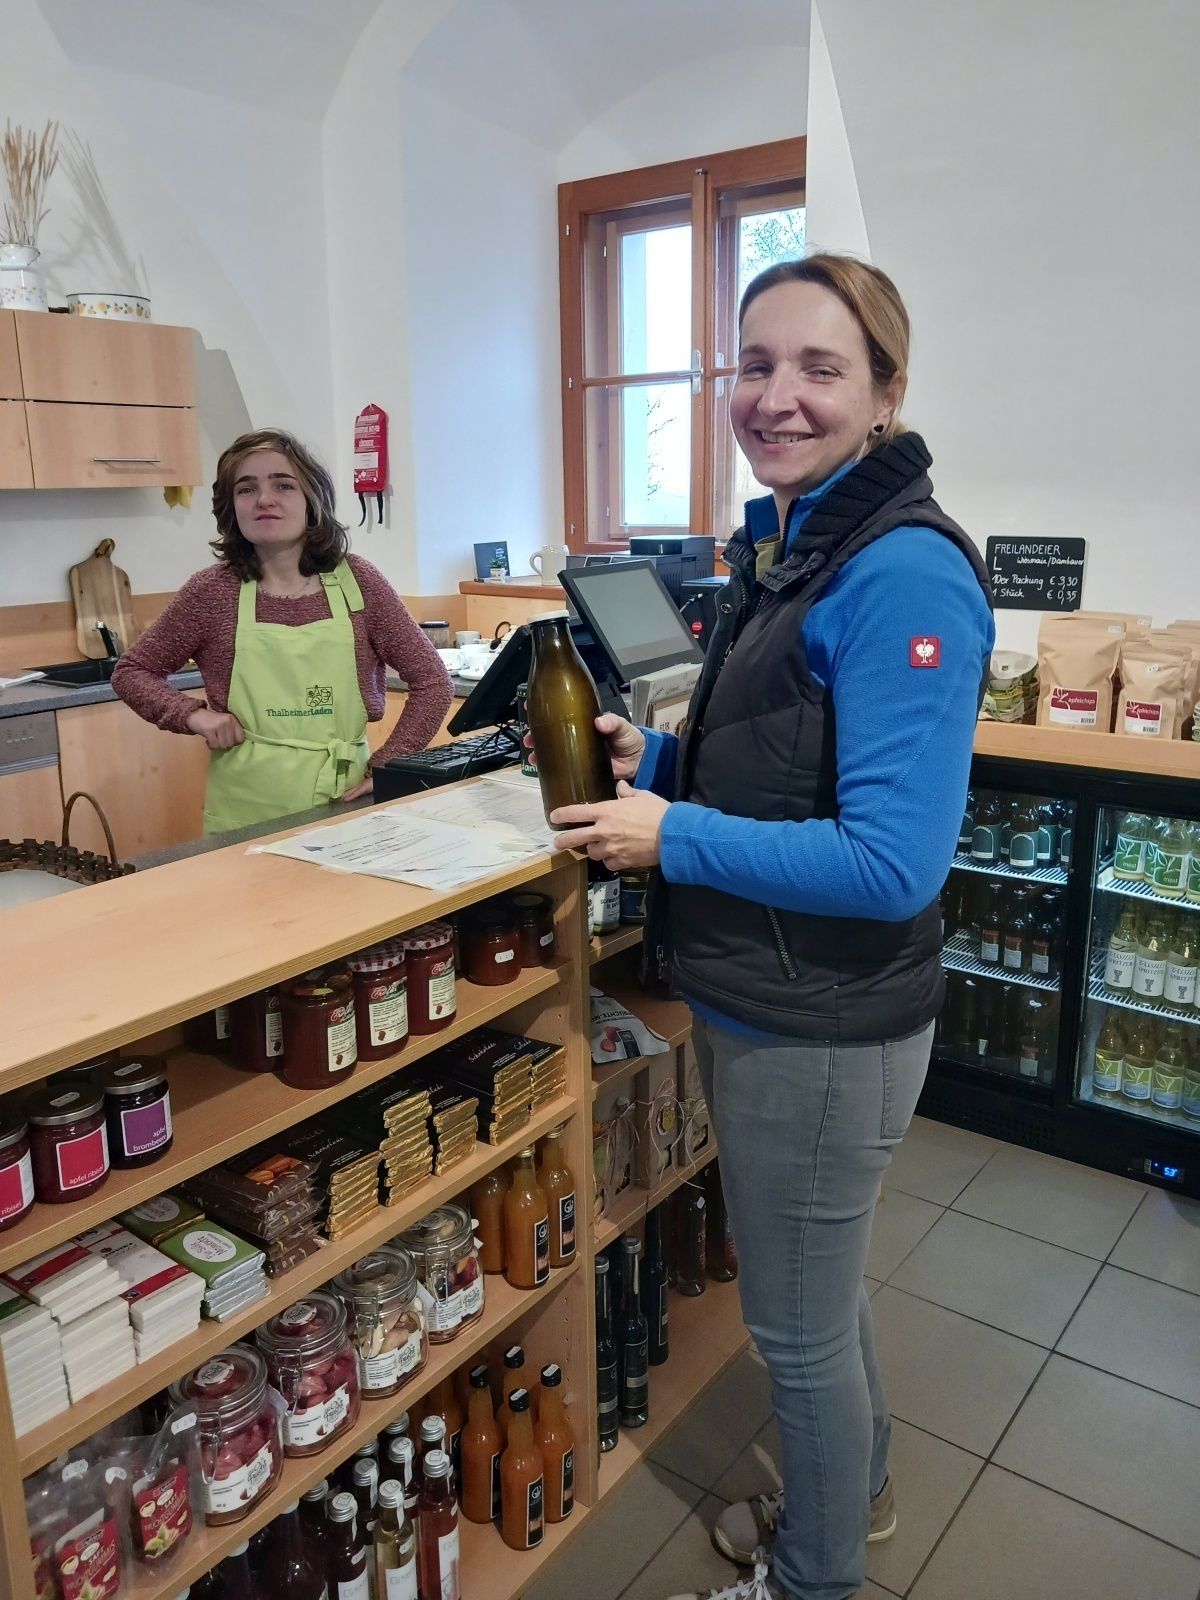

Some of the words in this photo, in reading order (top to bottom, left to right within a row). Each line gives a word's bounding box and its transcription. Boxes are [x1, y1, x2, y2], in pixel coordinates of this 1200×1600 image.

[995, 544, 1061, 555] FREILANDEIER
[993, 556, 1002, 571] L
[1012, 574, 1044, 590] Packung
[1049, 576, 1056, 585] €
[1058, 576, 1078, 590] 3,30
[1000, 588, 1025, 598] Stück
[1046, 590, 1053, 599] €
[1057, 590, 1077, 605] 0,35
[1068, 697, 1096, 705] apfelchips
[152, 1126, 166, 1138] apfel
[133, 1134, 167, 1152] brombeere
[69, 1174, 87, 1186] apfel
